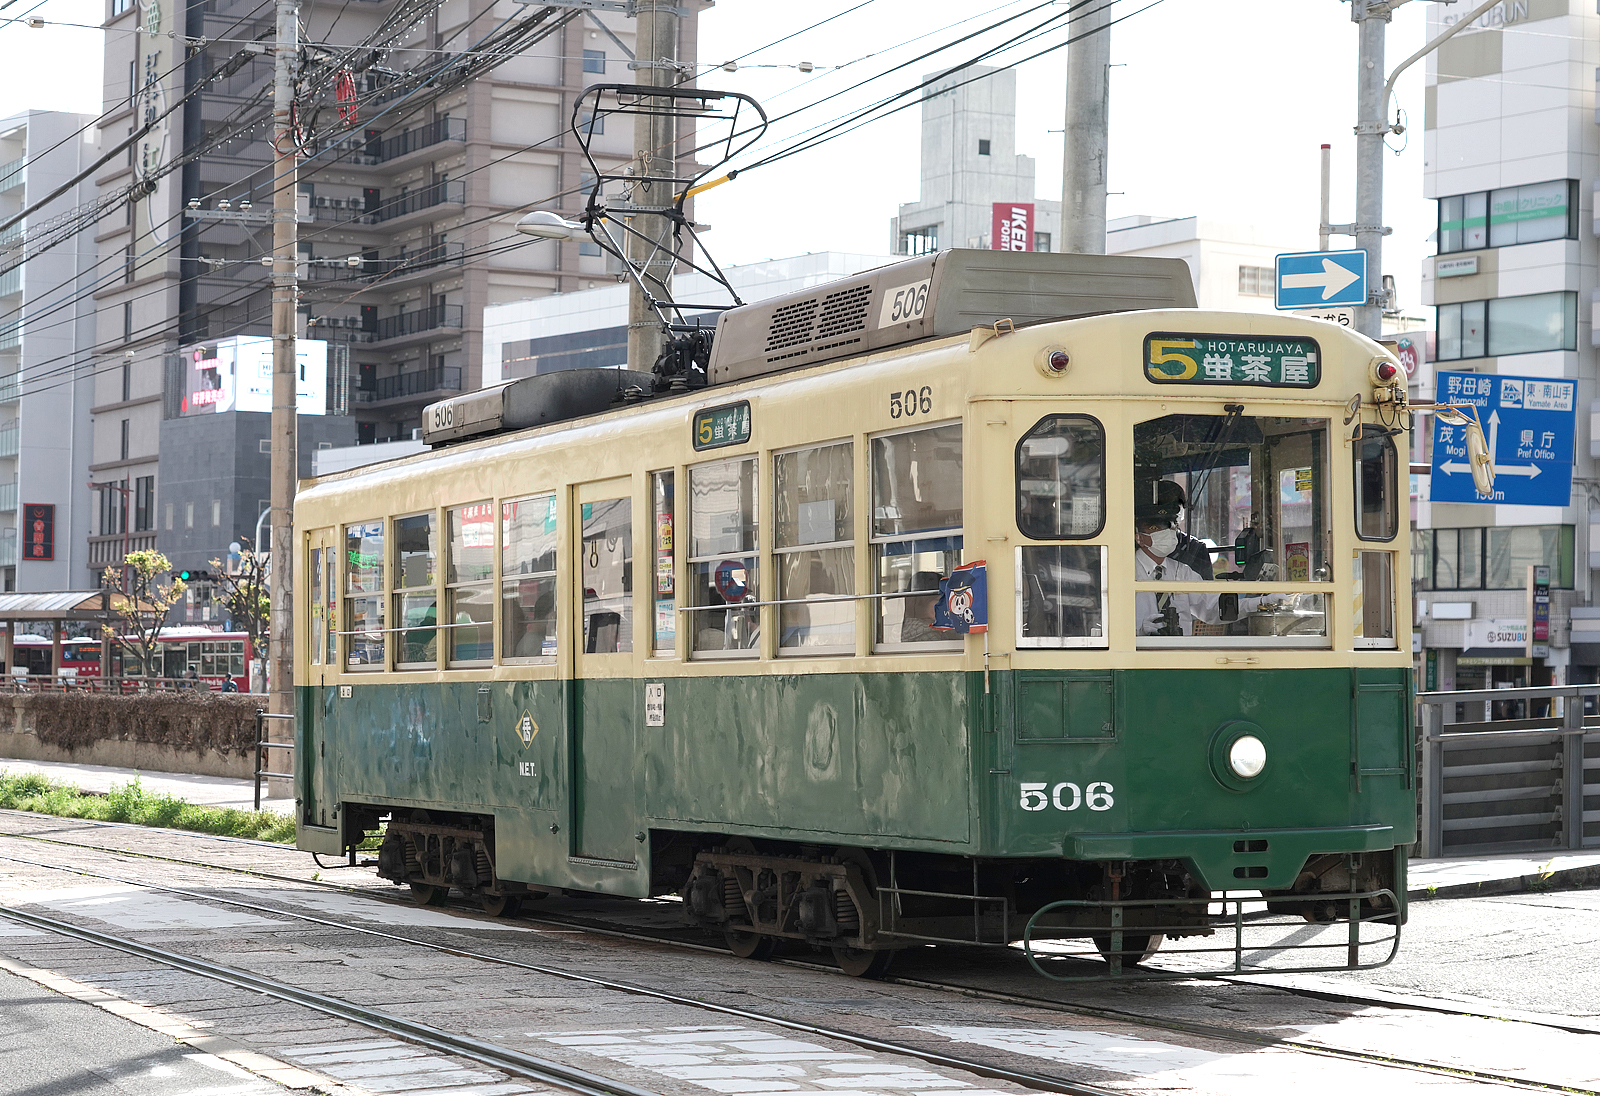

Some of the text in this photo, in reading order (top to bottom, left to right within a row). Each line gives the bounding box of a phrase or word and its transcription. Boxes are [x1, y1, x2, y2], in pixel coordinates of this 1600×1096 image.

[892, 284, 928, 321] 506
[1148, 340, 1303, 380] 5 HOTARUJAYA
[1203, 353, 1310, 384] 蛍茶屋
[1448, 376, 1491, 396] 野母崎
[1526, 383, 1571, 400] 東・南山手
[890, 386, 932, 419] 506
[1529, 399, 1568, 409] Yamate Area
[435, 404, 453, 428] 506
[699, 418, 713, 443] 5
[1520, 430, 1555, 448] 県庁
[1446, 445, 1466, 457] Mogi
[1534, 449, 1555, 460] Office
[519, 761, 537, 777] N.E.T.
[1019, 782, 1114, 812] 506
